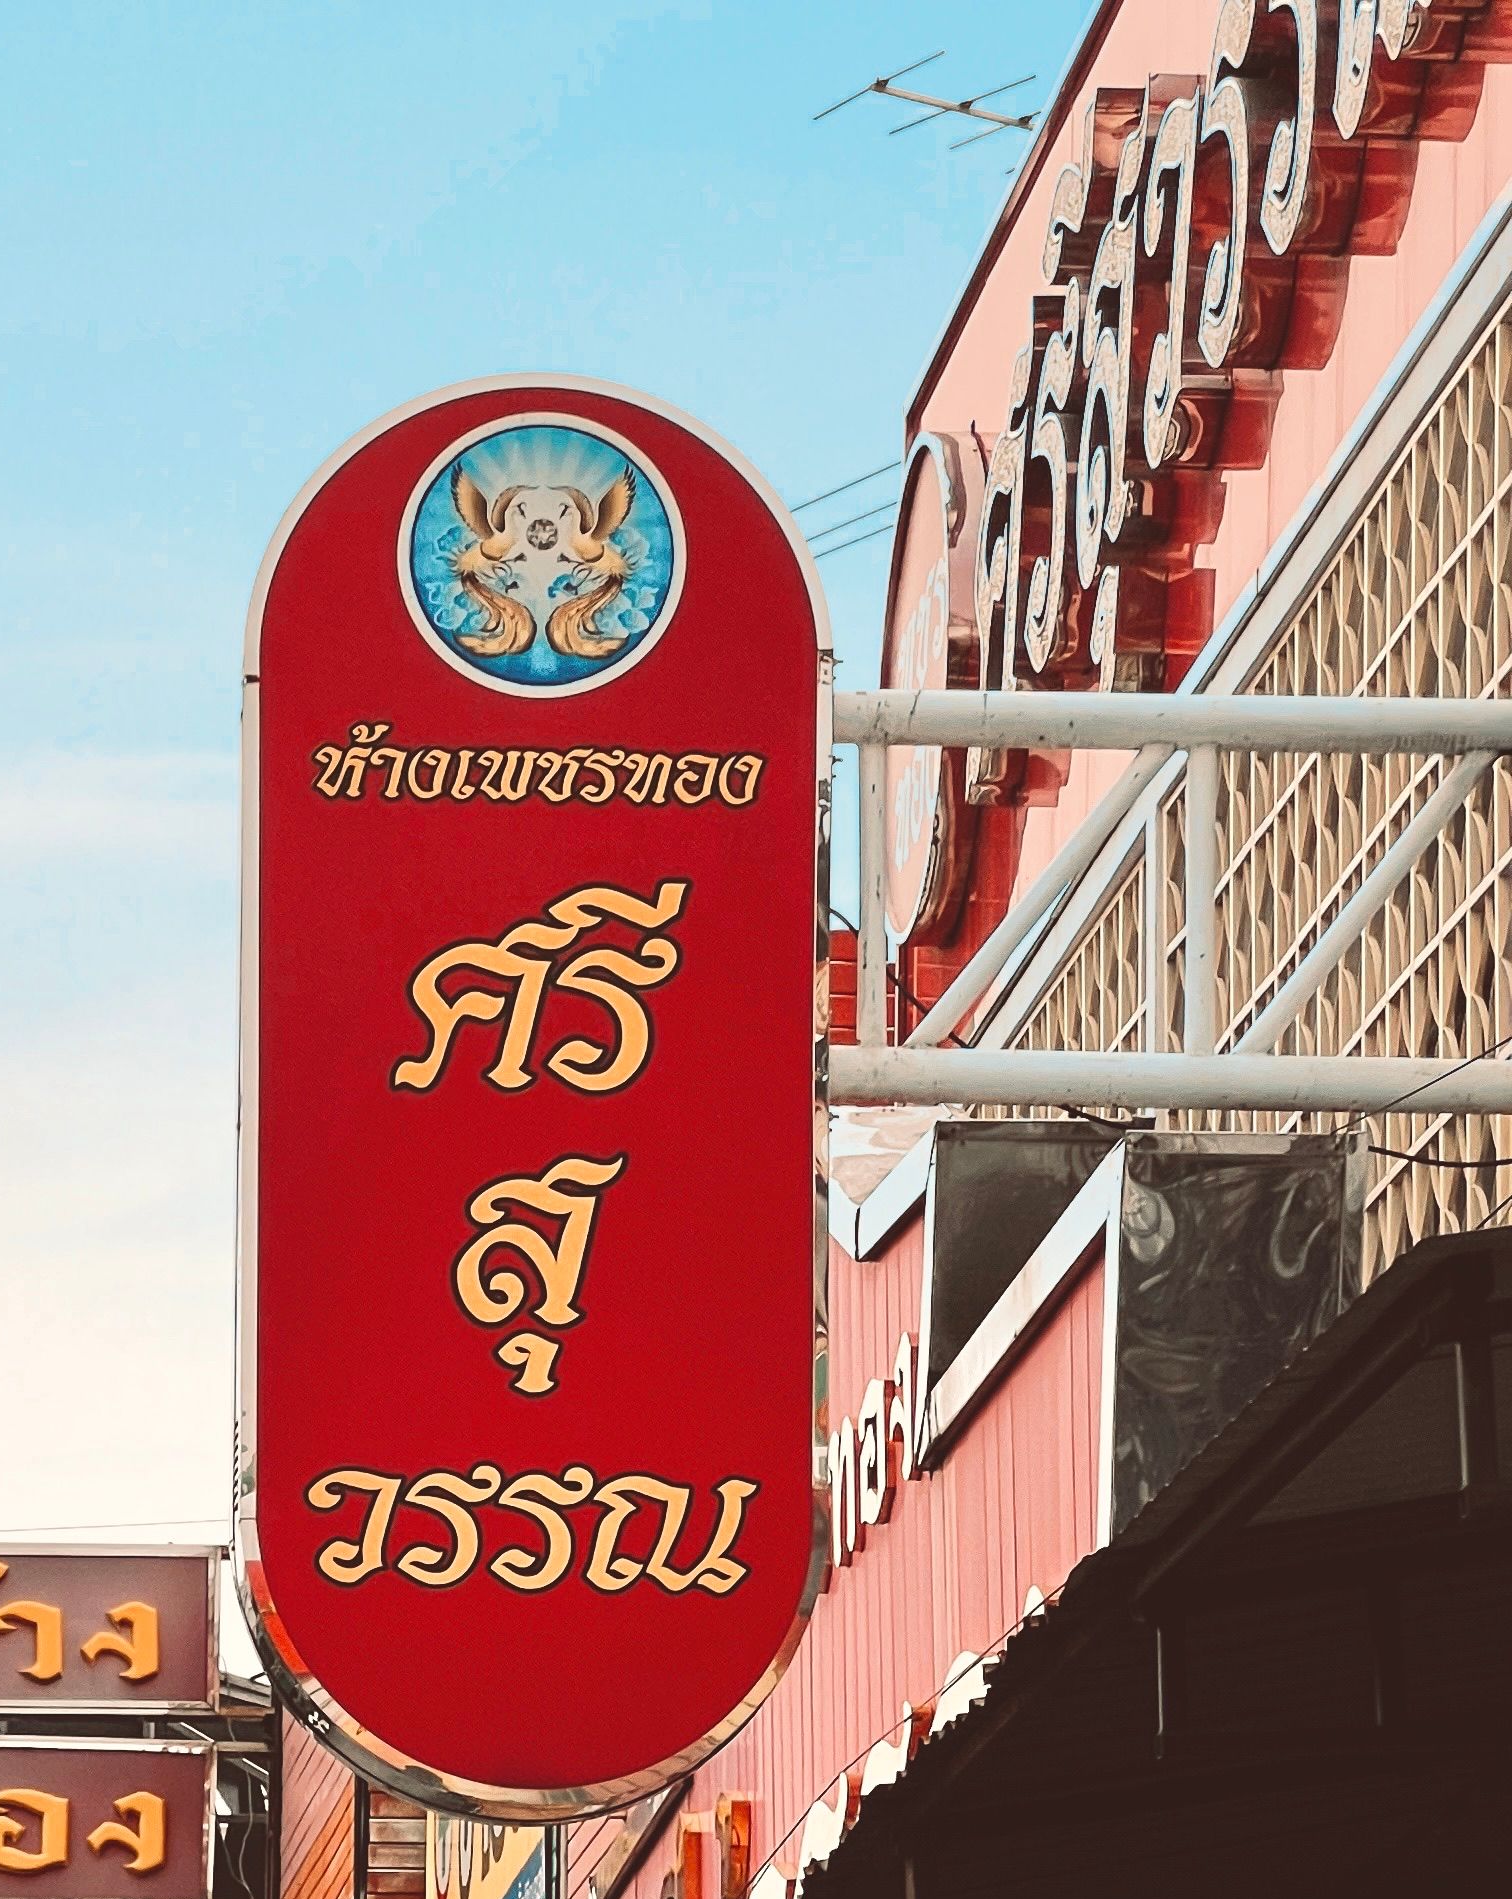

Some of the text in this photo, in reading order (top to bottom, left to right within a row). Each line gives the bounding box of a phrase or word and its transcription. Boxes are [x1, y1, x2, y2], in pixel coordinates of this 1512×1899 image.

[313, 722, 765, 805] ห้างเพชรทอง
[392, 879, 691, 1094] ศรี
[454, 1155, 624, 1394] สุ
[307, 1466, 758, 1594] วรรณ
